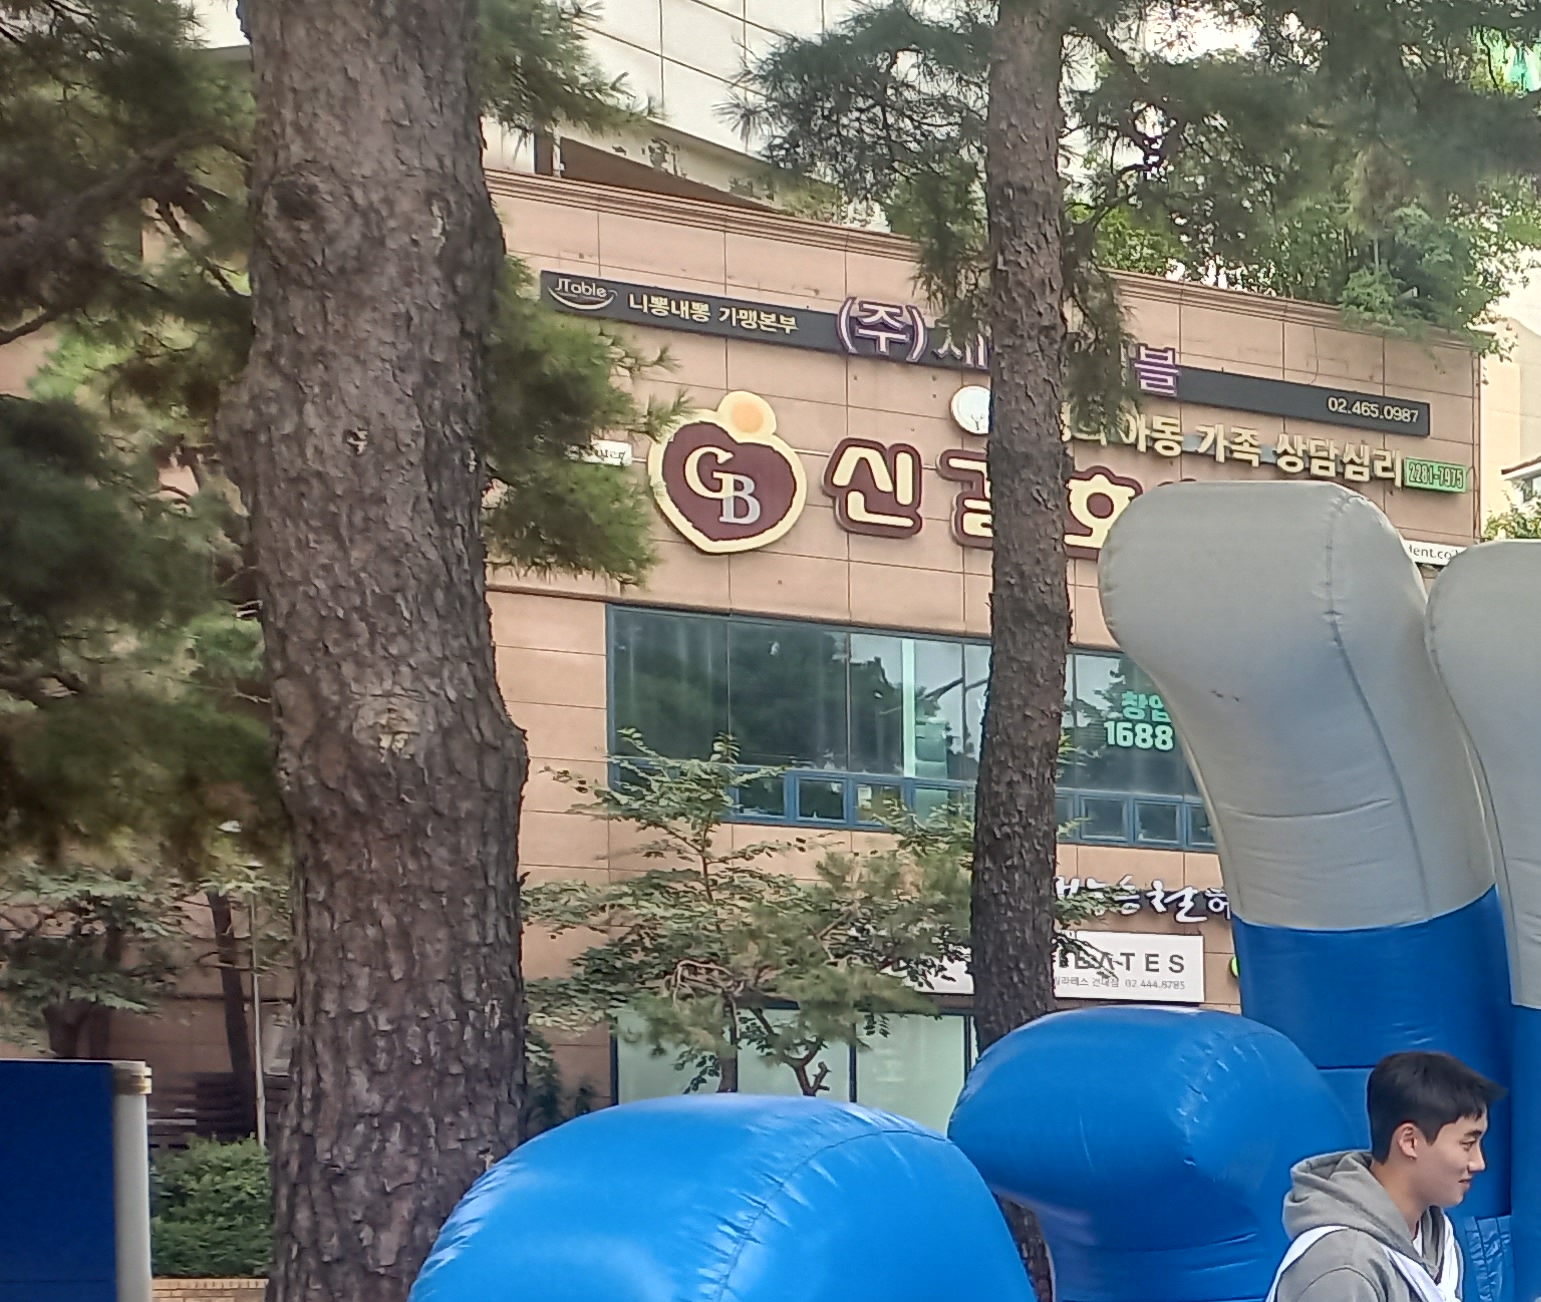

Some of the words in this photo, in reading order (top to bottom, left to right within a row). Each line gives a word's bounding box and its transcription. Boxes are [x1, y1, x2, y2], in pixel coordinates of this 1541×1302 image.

[629, 294, 712, 323] 니뽕내뽕
[1328, 397, 1420, 423] 02.465.0987
[1196, 424, 1261, 467] 가족
[1274, 433, 1402, 488] 상담심리
[684, 445, 761, 525] GB
[1408, 462, 1464, 489] 2281-7975
[1104, 720, 1174, 751] 1688
